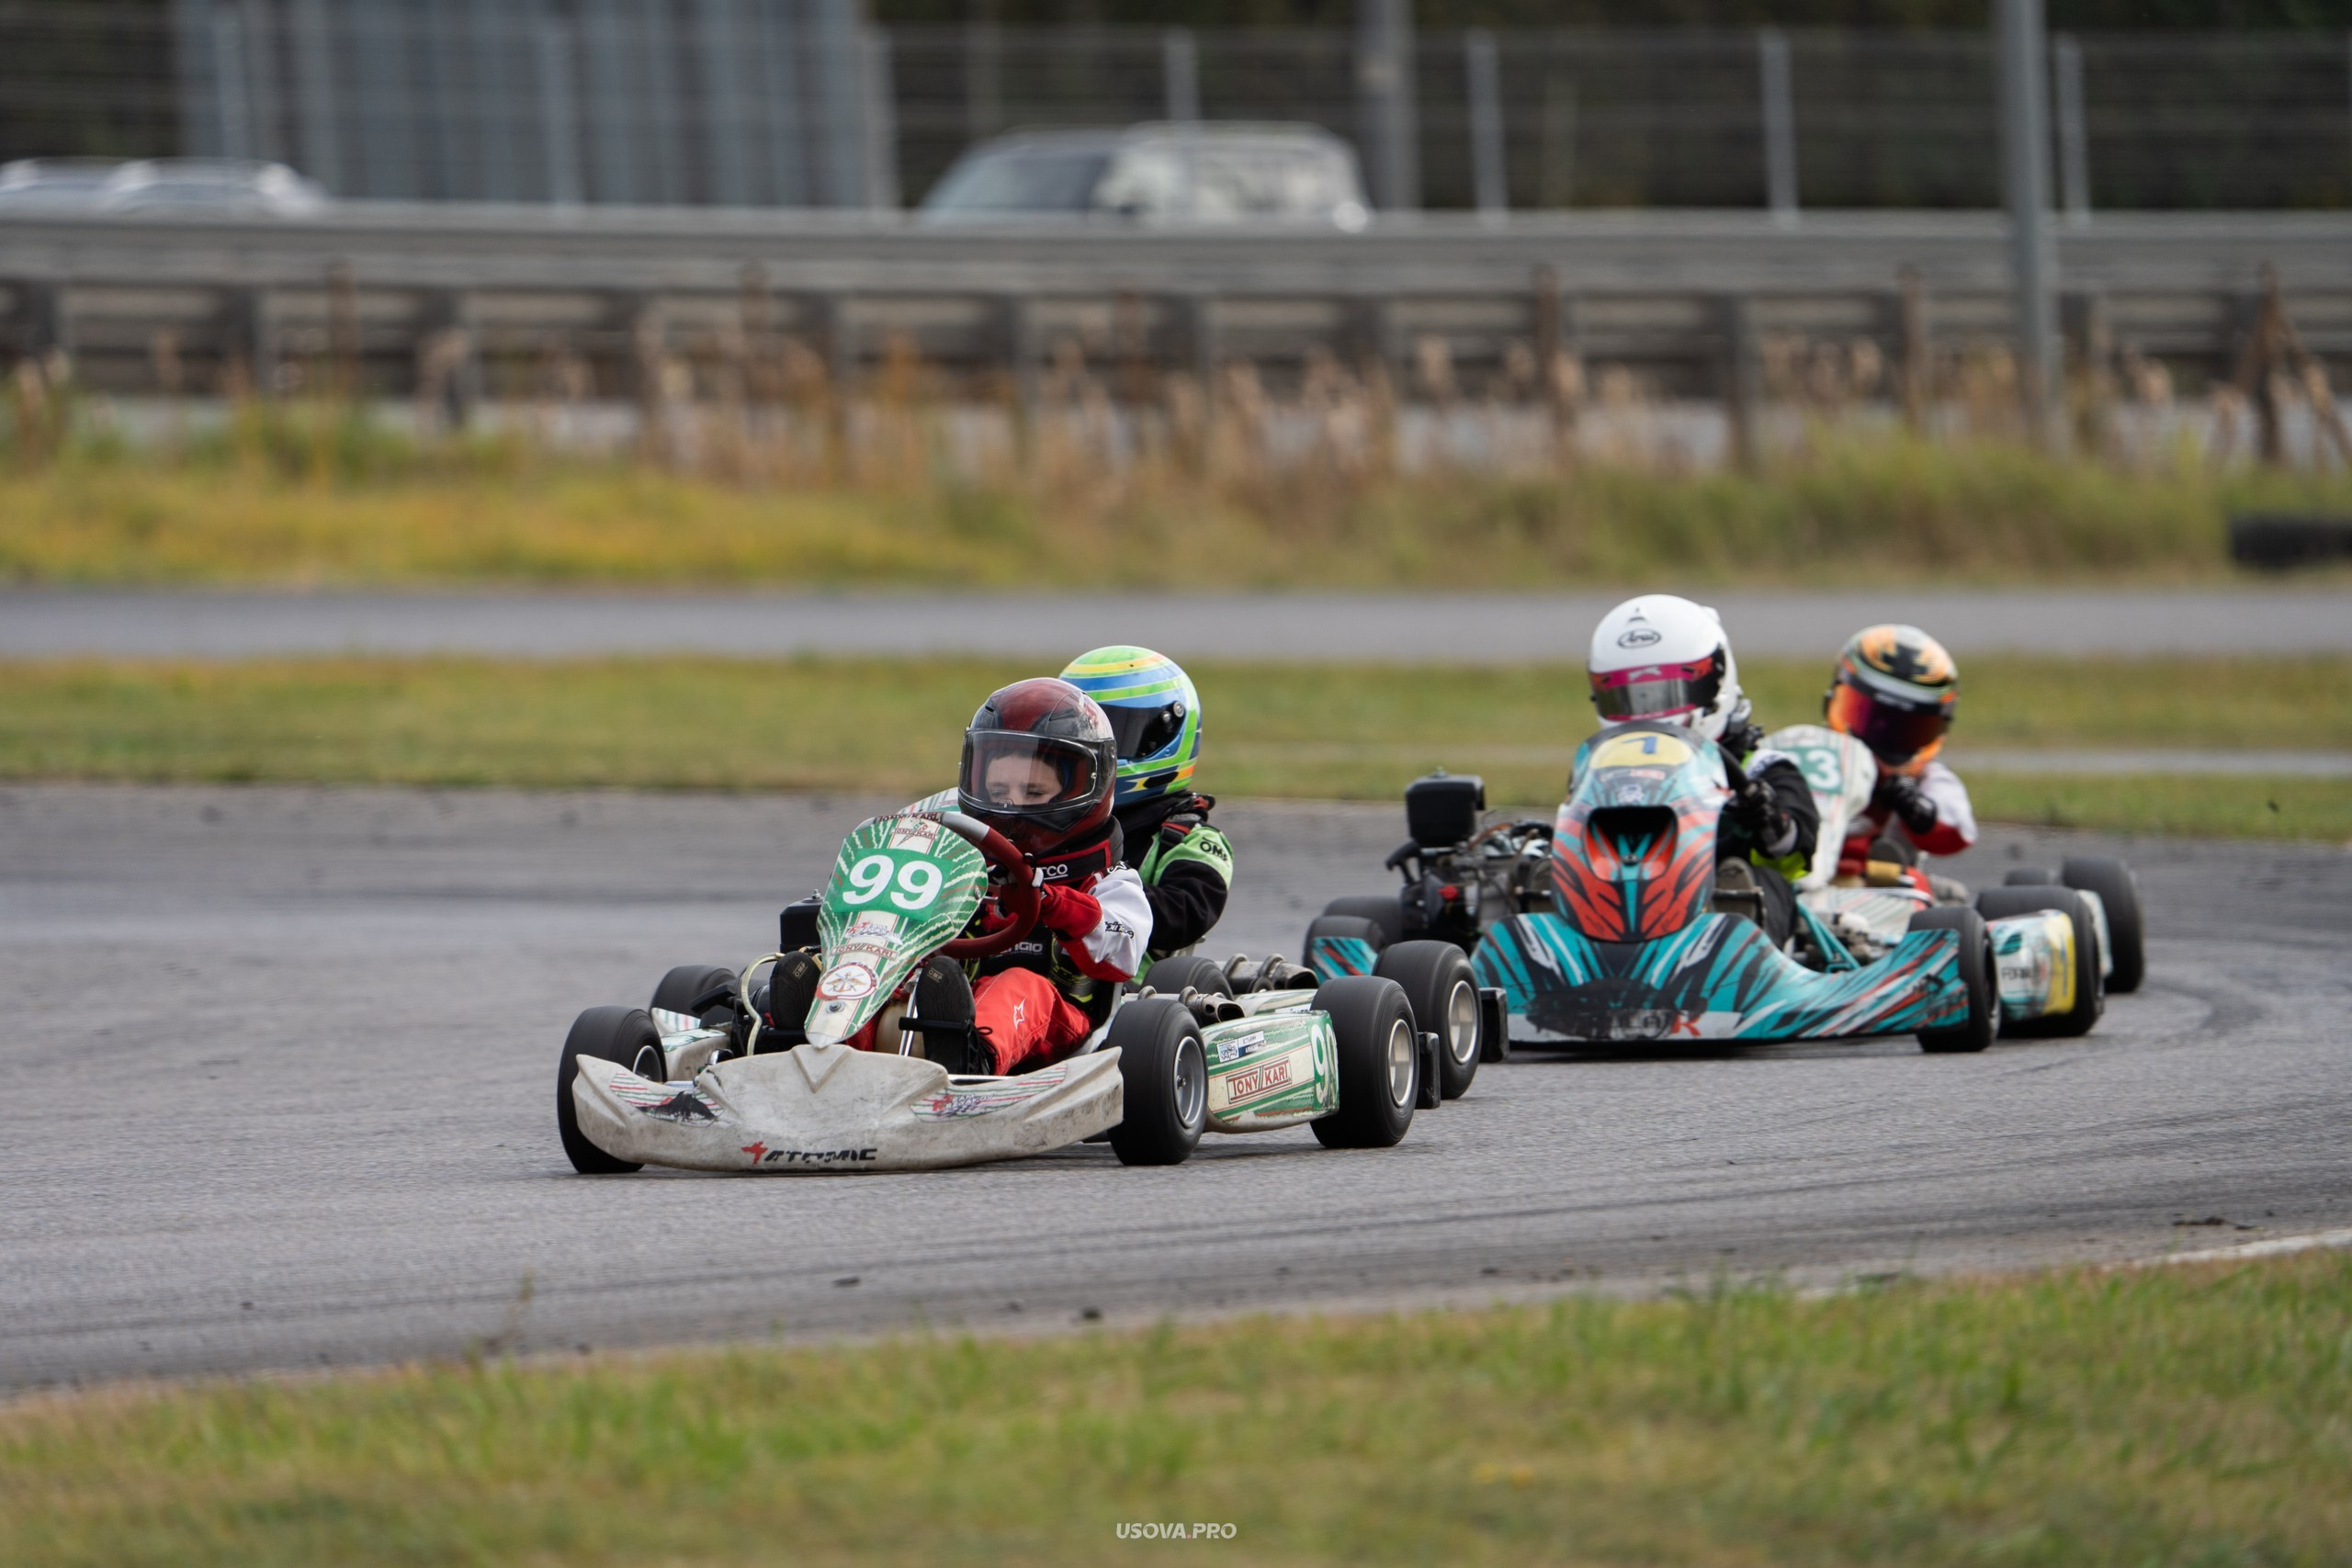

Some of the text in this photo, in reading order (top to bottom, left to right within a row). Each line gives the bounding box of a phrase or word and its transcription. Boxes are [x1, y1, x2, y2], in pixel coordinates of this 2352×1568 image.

[1621, 736, 1657, 755] 1
[842, 854, 944, 910] 99
[1228, 1060, 1289, 1097] TONY KART
